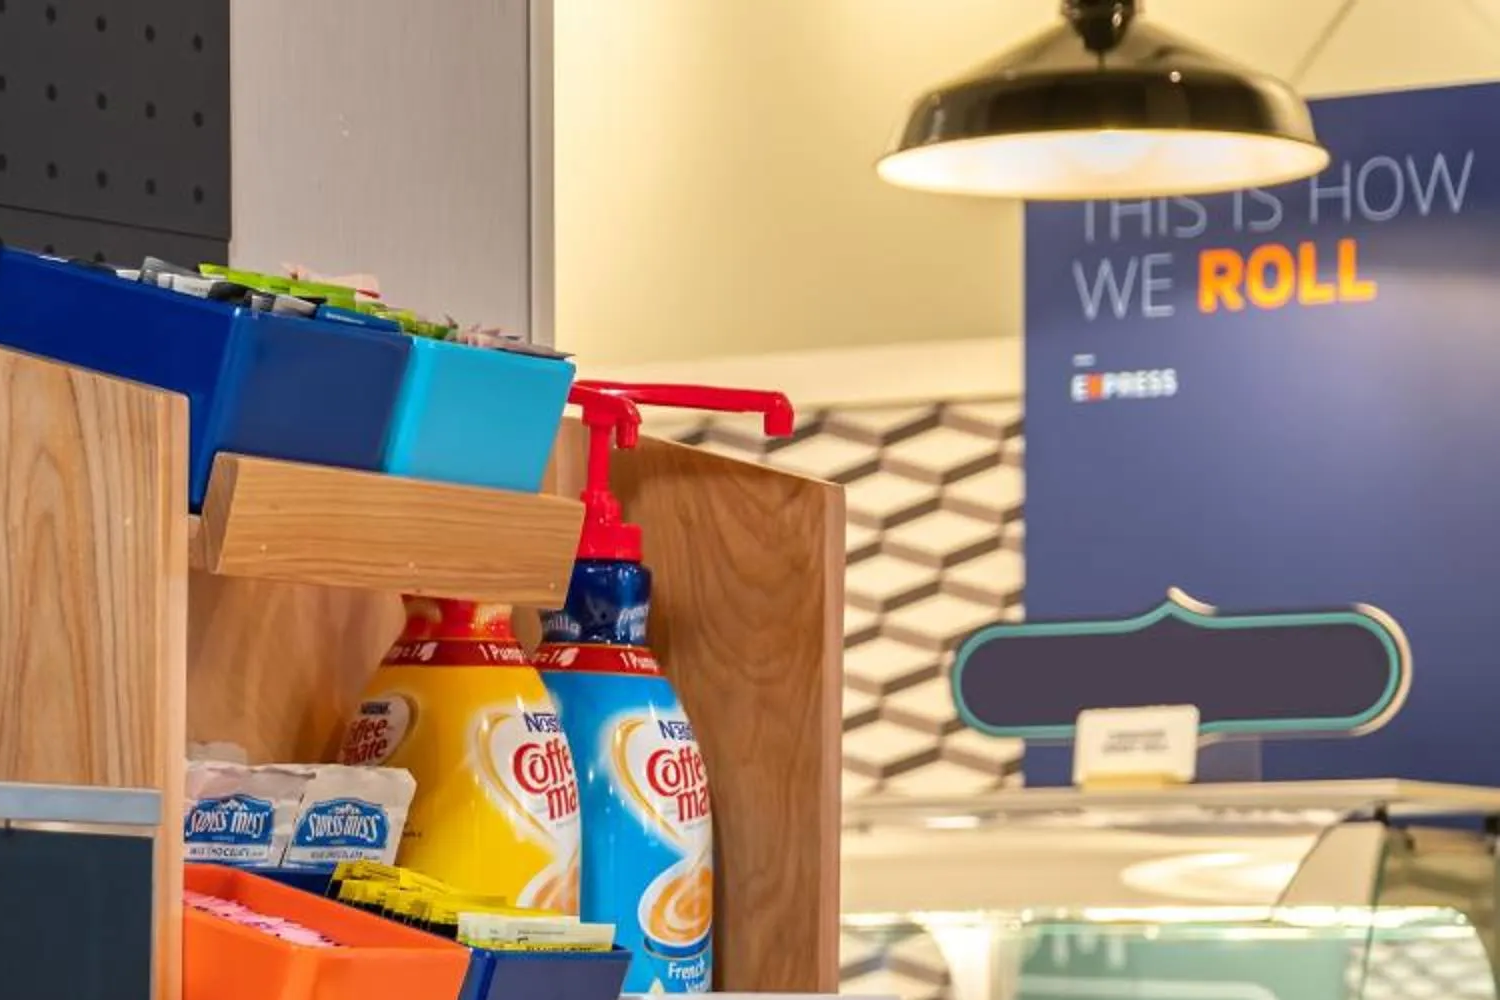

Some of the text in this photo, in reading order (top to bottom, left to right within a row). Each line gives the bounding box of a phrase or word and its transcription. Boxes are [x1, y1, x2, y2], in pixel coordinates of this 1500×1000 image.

[1308, 150, 1475, 225] HOW
[1072, 237, 1378, 321] WE ROLL
